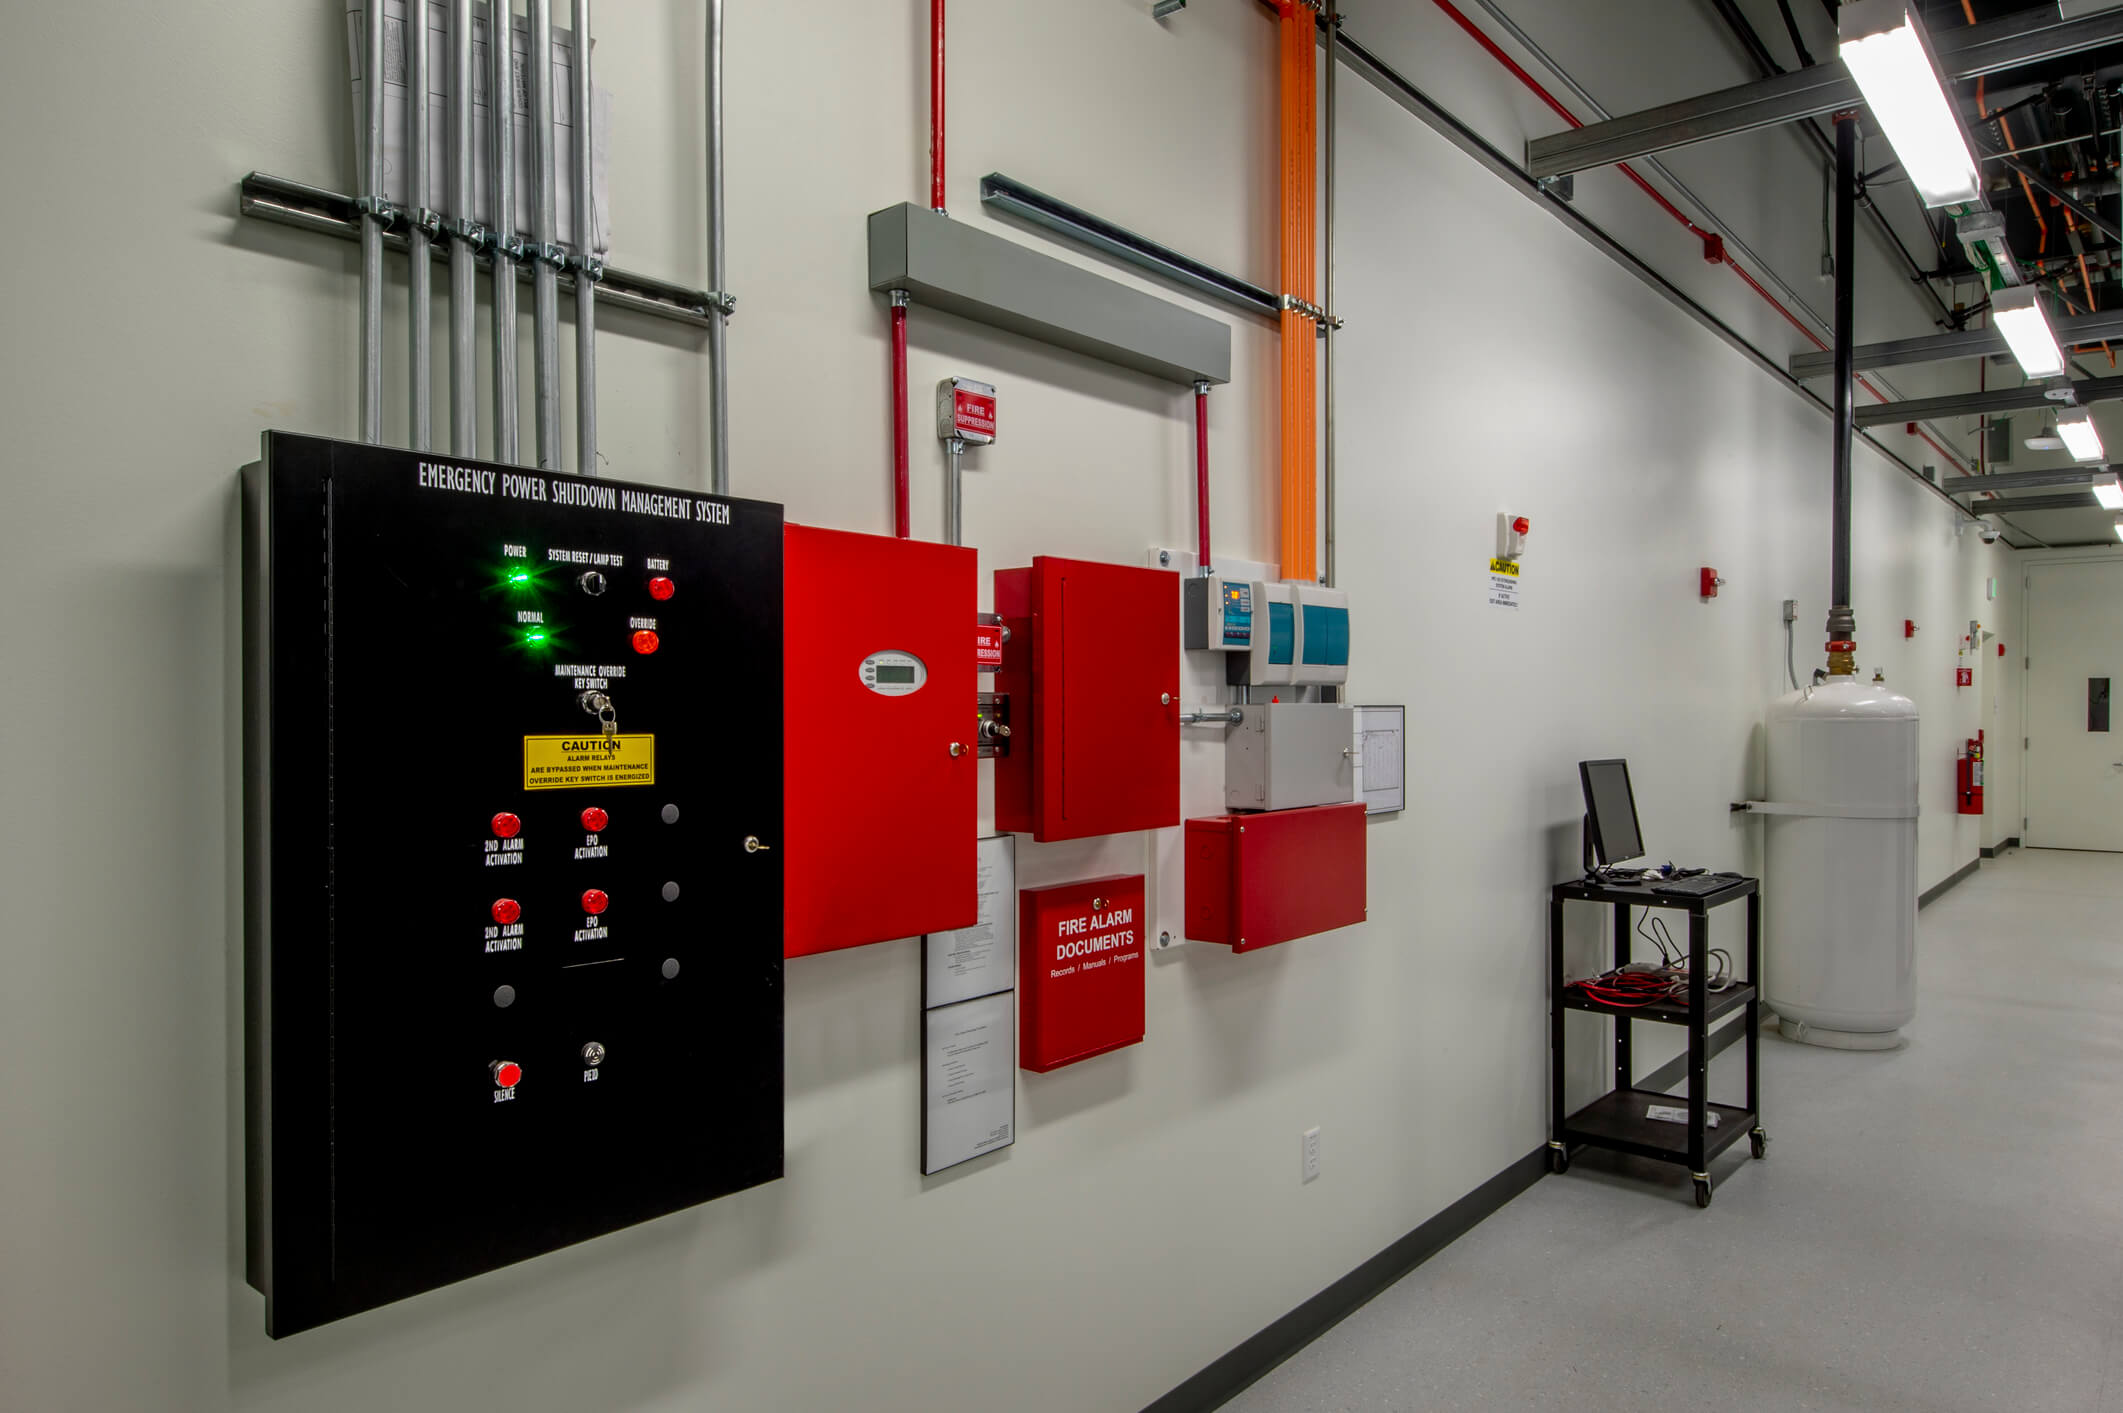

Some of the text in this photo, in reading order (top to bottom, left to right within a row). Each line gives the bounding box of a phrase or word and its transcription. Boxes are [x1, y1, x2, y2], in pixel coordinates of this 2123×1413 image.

[966, 403, 985, 416] FIRE
[419, 462, 729, 525] EMERGENCY POWER SHUTDOWN MANAGEMENT SYSTEM
[504, 544, 526, 557] POWER
[548, 549, 570, 562] SYSTEM
[572, 551, 588, 563] RESET
[593, 552, 609, 565] LAMP
[610, 555, 622, 567] TEST
[647, 558, 668, 570] BATTERY
[518, 611, 543, 623] NORMAL
[630, 617, 656, 630] OVERRIDE
[977, 636, 991, 645] IRE
[977, 649, 1000, 657] RESSION
[555, 665, 626, 677] MAINTENANCE OVERRIDE
[575, 678, 608, 689] KEY SWITCH
[562, 741, 620, 751] CAUTION
[530, 776, 563, 784] OVERRIDE
[485, 838, 524, 852] 2ND ALARM
[587, 835, 598, 845] EPO
[485, 852, 522, 866] ACTIVATION
[575, 846, 608, 859] ACTIVATION
[587, 916, 598, 928] EPO
[1059, 909, 1132, 936] FIRE ALARM
[485, 924, 523, 939] 2ND ALARM
[575, 927, 608, 942] ACTIVATION
[485, 938, 522, 952] ACTIVATION
[1057, 930, 1133, 960] DOCUMENTS
[1051, 967, 1075, 978] Records
[1083, 959, 1106, 970] Manuals
[1114, 952, 1139, 963] Programs
[494, 1087, 515, 1103] SILENCE
